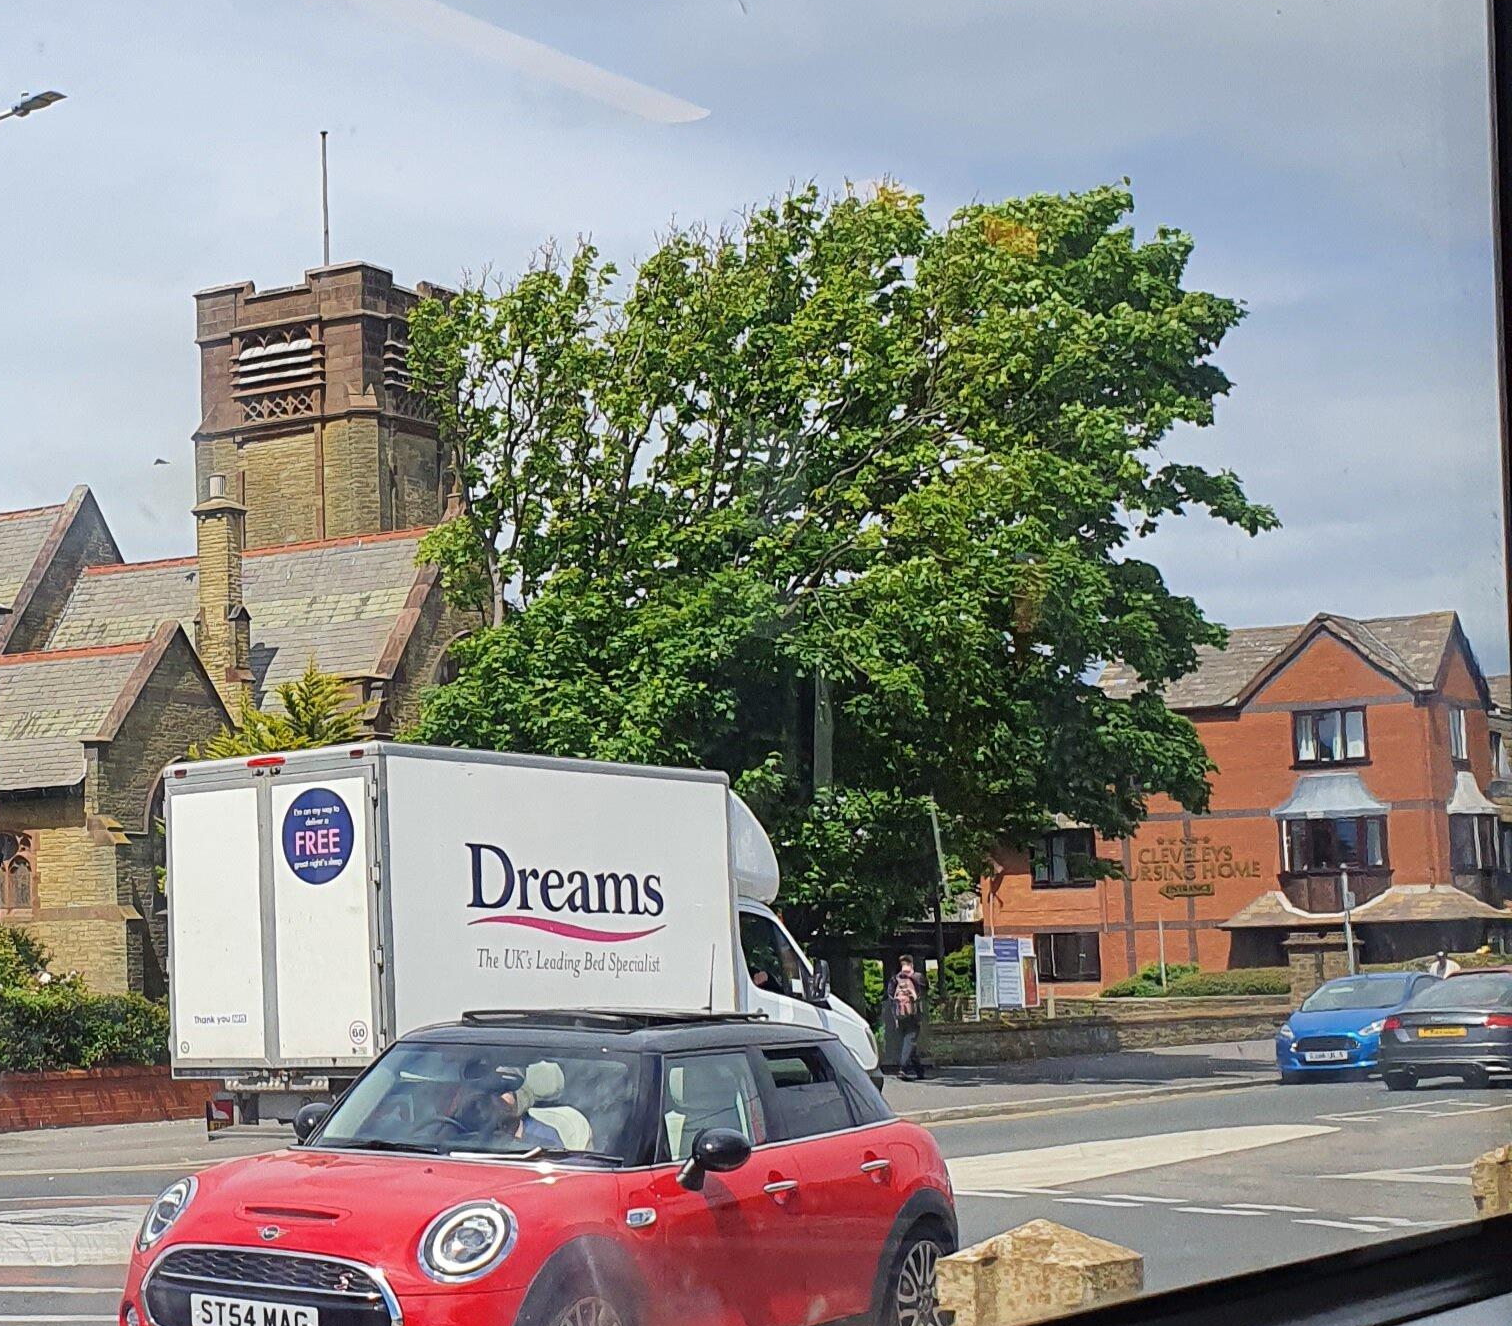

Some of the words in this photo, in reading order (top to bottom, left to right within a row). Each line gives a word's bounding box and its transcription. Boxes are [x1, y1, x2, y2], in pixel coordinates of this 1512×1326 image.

[295, 828, 340, 856] FREE
[1138, 845, 1233, 865] CLEVELEYS
[465, 843, 664, 916] Dreams
[1203, 860, 1261, 879] HOME
[477, 948, 499, 969] The
[504, 948, 532, 969] UK's
[536, 950, 581, 978] Leading
[584, 952, 605, 971] Bed
[608, 952, 660, 978] Specialist
[194, 1014, 216, 1024] Thank
